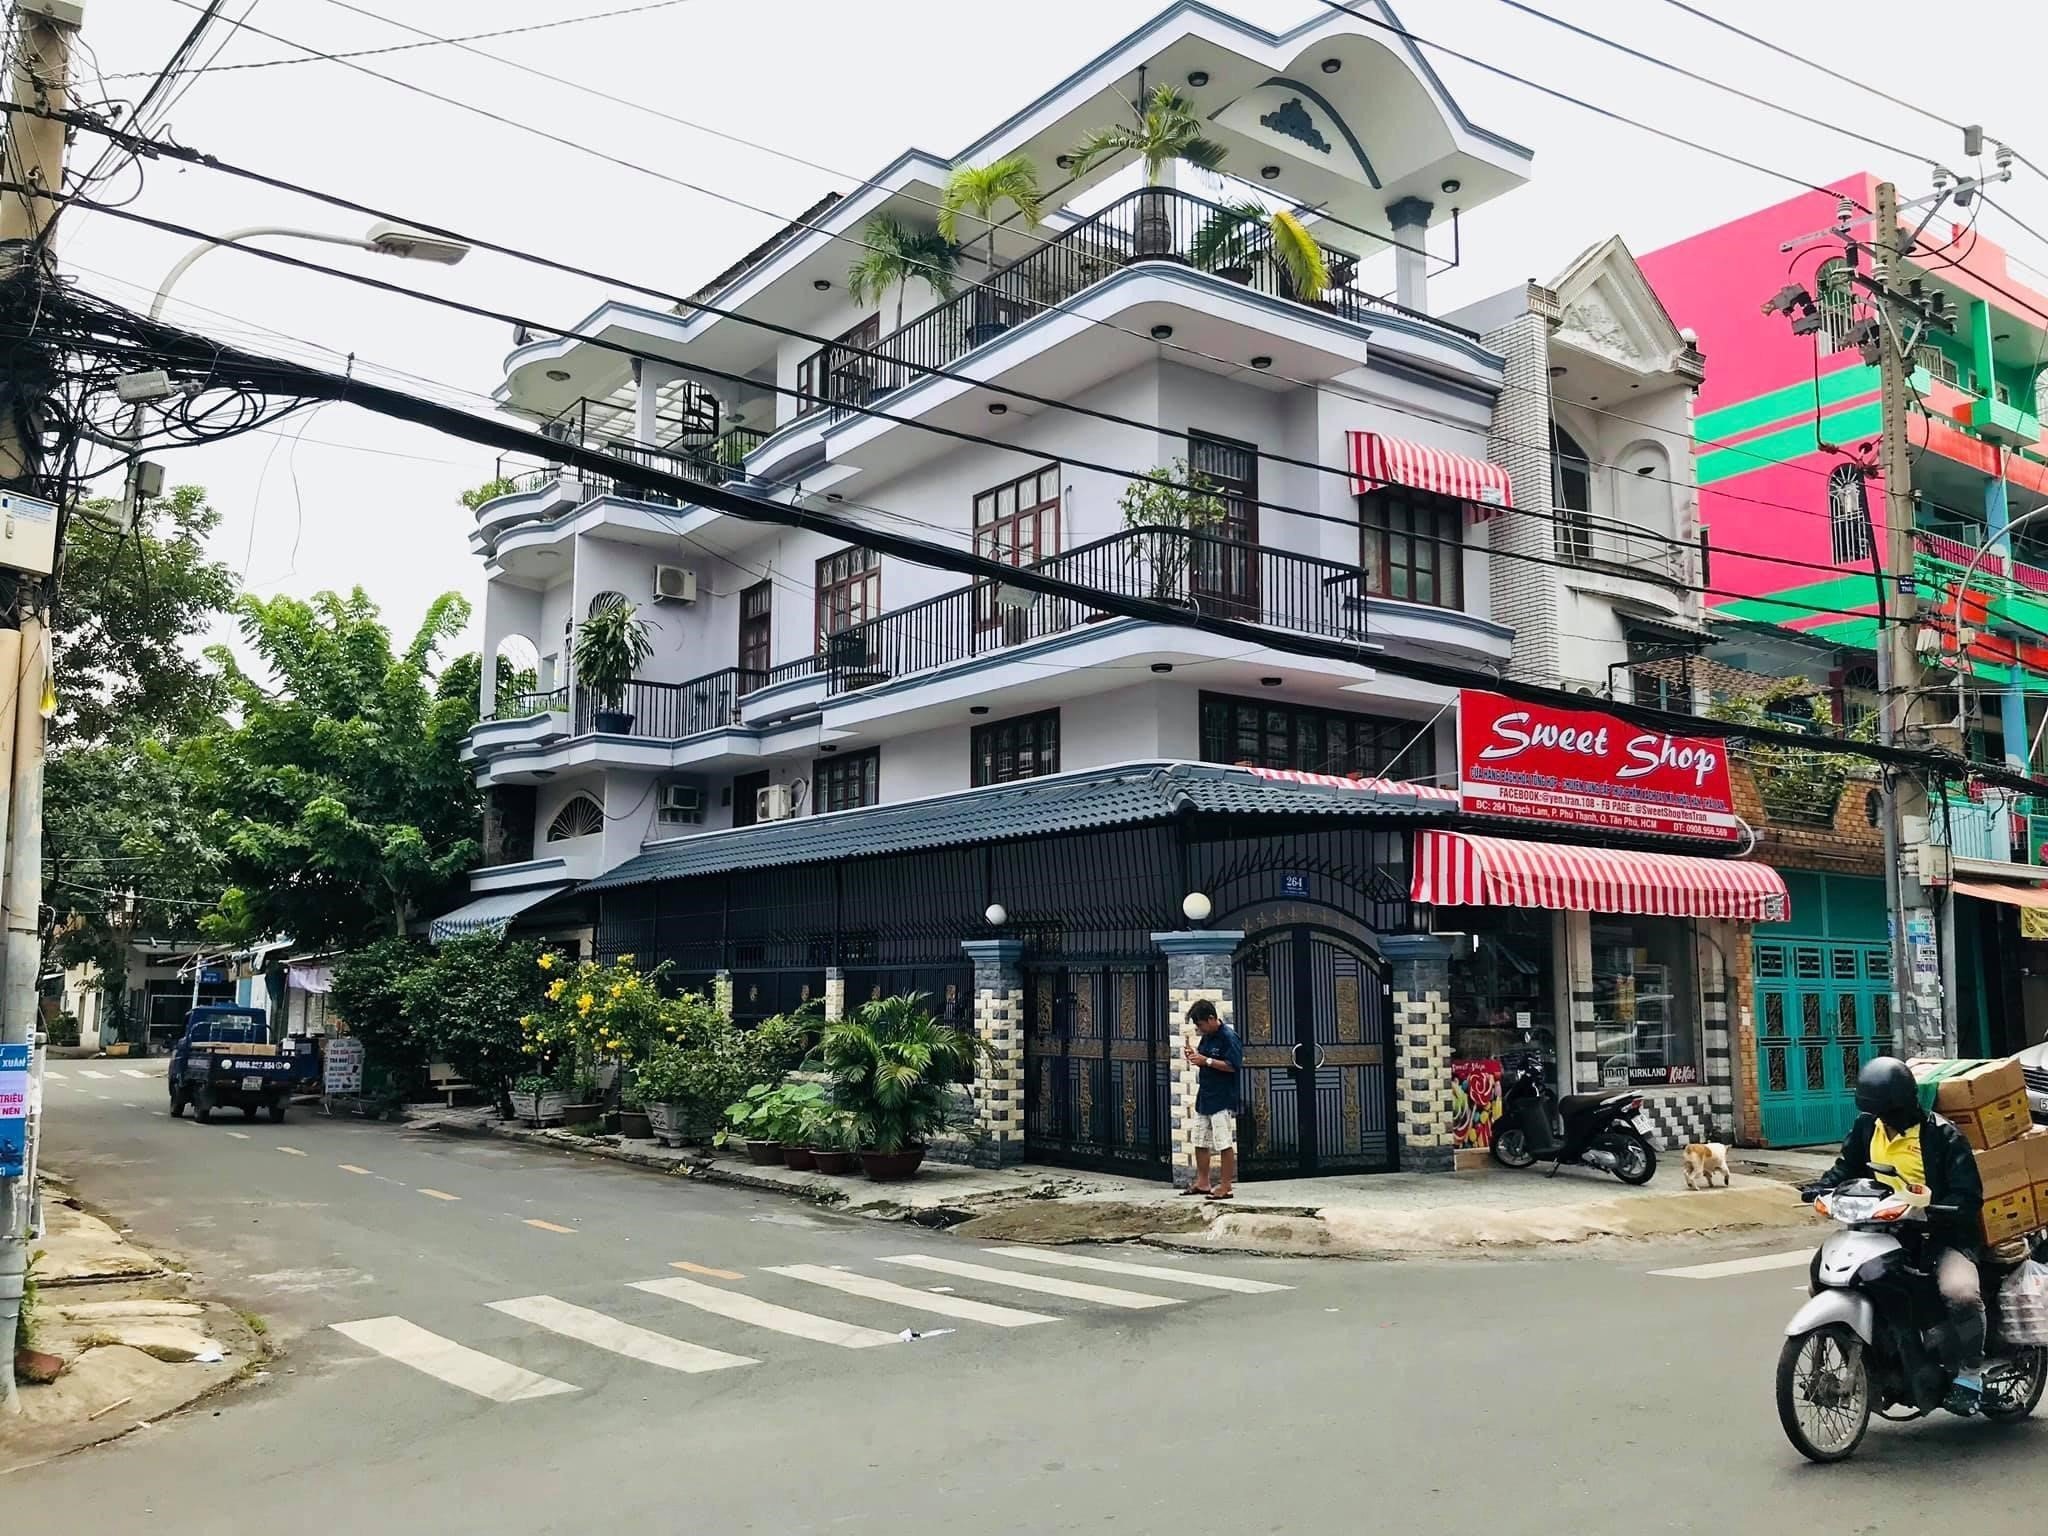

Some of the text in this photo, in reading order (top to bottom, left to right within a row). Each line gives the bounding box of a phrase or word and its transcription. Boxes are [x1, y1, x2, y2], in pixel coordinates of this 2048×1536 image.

[1479, 712, 1716, 786] Sweet Shop
[1602, 799, 1610, 810] FB
[1612, 801, 1632, 813] PAGE:
[1508, 803, 1530, 815] Thạch
[1532, 806, 1550, 818] Lam,
[1552, 807, 1558, 817] P.
[1560, 808, 1574, 819] Phú
[1610, 814, 1622, 825] Tân
[1641, 818, 1657, 829] HCM
[1629, 1068, 1666, 1078] KIRKLAND
[1669, 1066, 1696, 1084] KitKat
